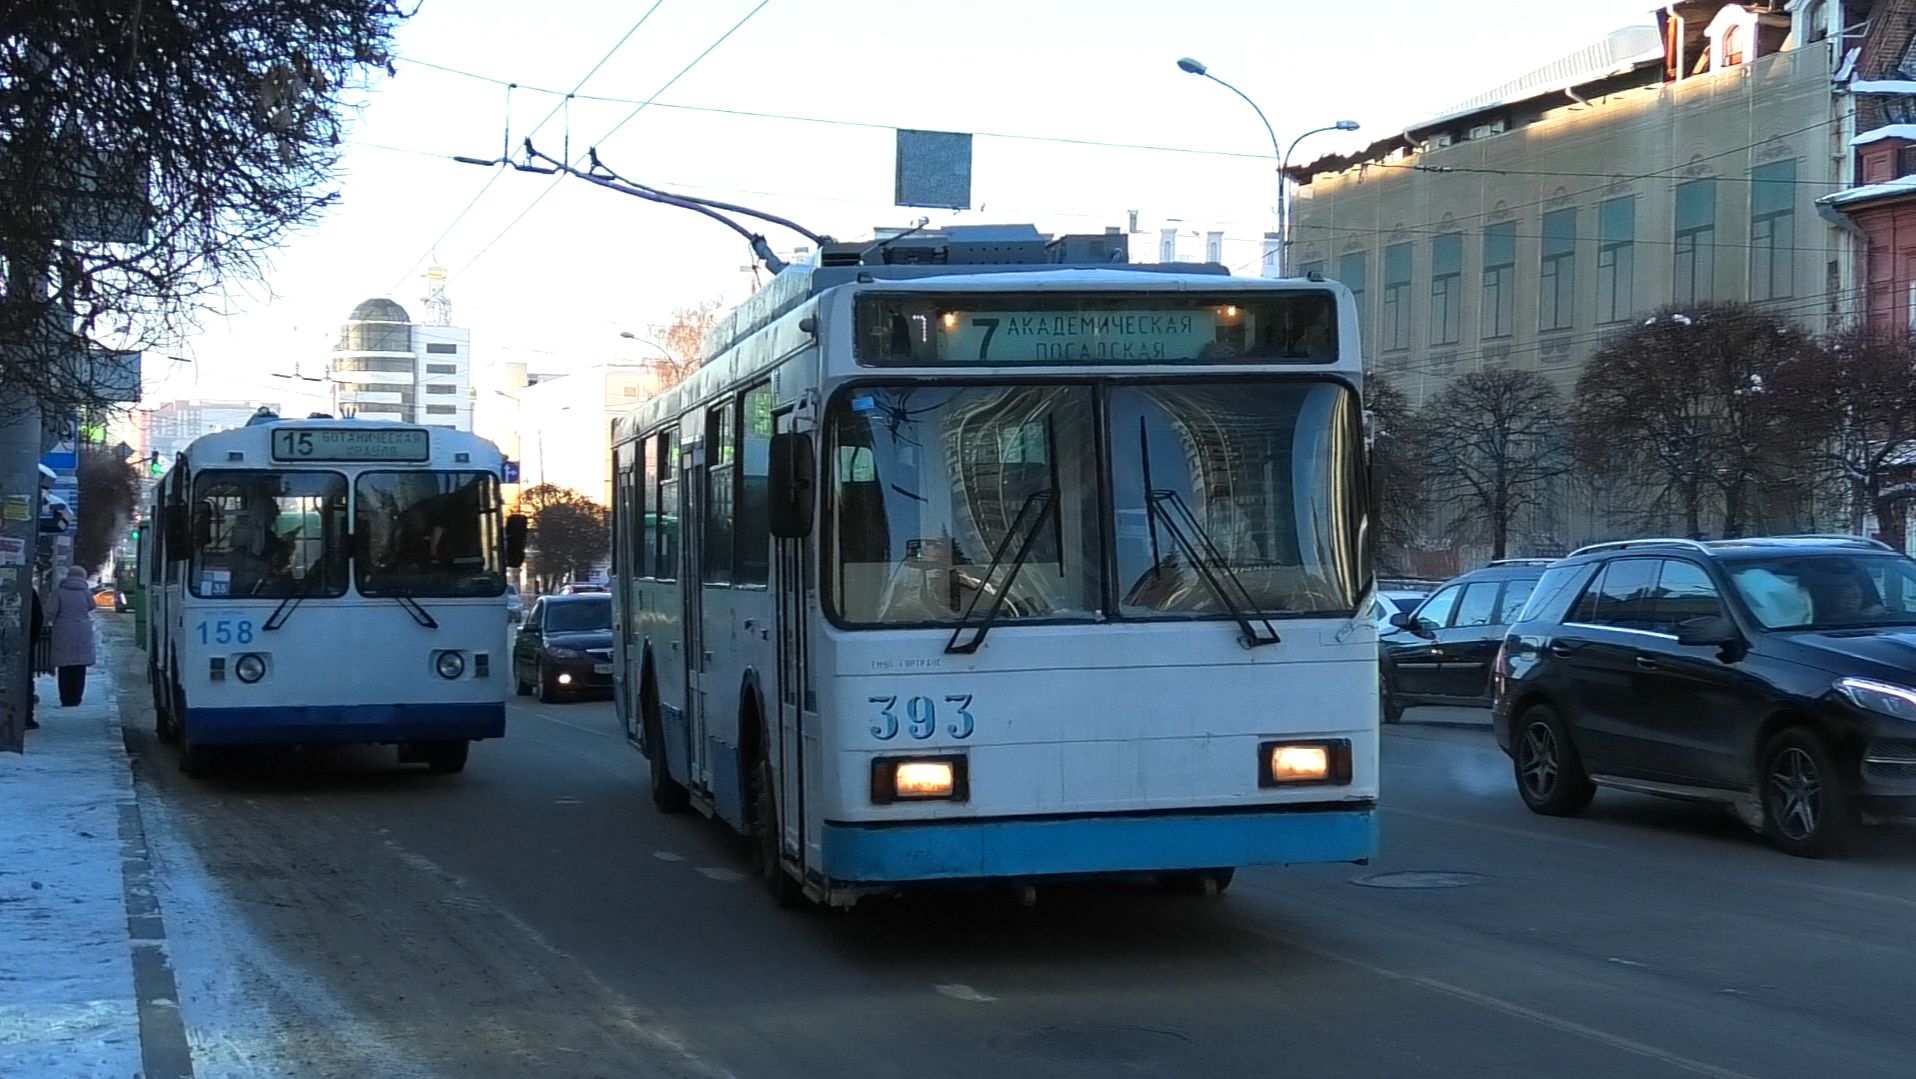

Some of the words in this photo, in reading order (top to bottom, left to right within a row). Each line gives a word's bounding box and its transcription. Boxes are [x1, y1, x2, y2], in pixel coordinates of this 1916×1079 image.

[971, 317, 1000, 361] 7
[1007, 315, 1193, 337] АКАДЕМИЧЕСКАЯ
[1035, 341, 1166, 361] ПОСАДСКАЯ
[283, 431, 314, 457] 15
[321, 430, 421, 443] БОТАНИЧЕСКАЯ
[196, 620, 254, 645] 158
[868, 693, 975, 741] 393
